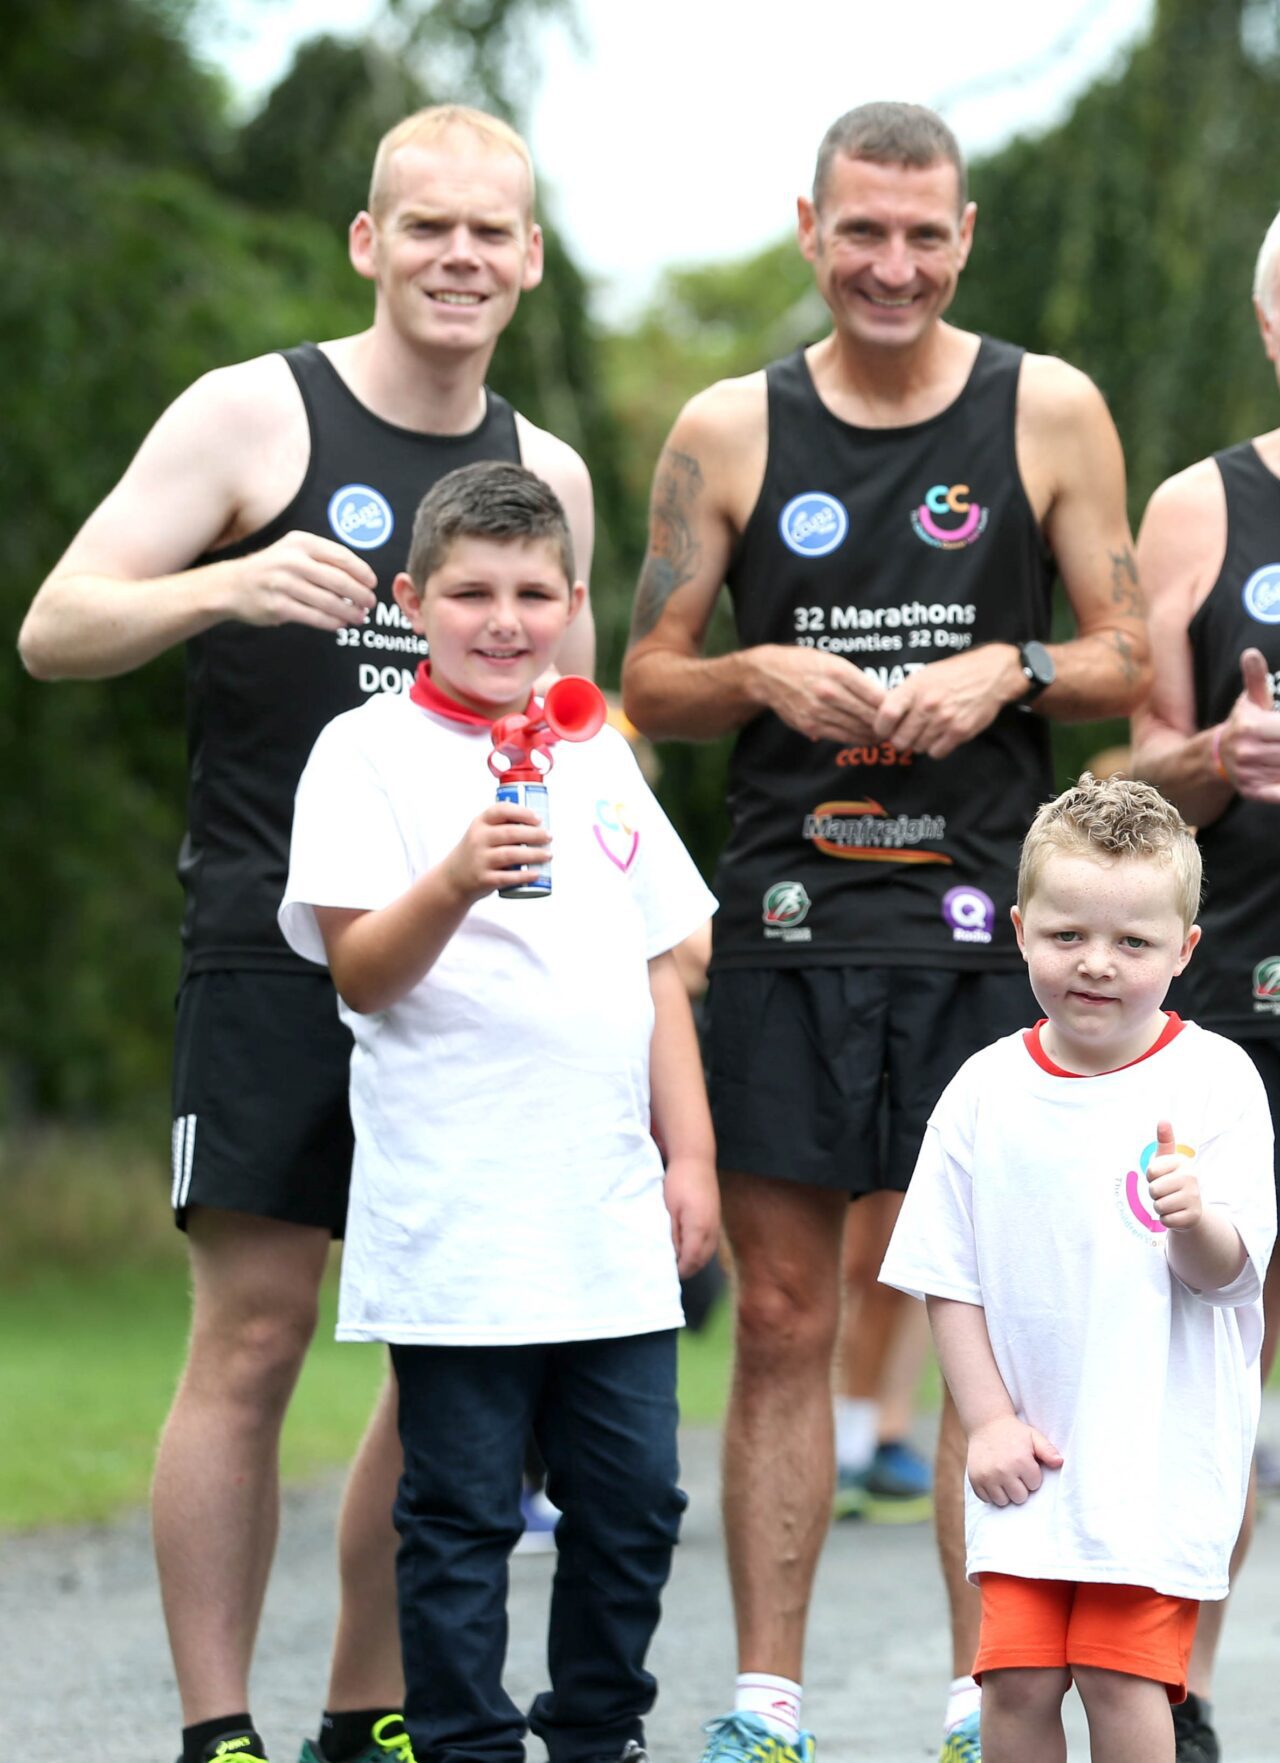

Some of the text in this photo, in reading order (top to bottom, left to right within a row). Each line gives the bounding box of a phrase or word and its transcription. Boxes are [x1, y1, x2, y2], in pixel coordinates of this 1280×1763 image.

[793, 601, 977, 631] 32 Marathons
[336, 627, 429, 655] 32 Countie
[908, 629, 932, 648] 32
[933, 629, 973, 650] Days
[951, 893, 986, 928] Q
